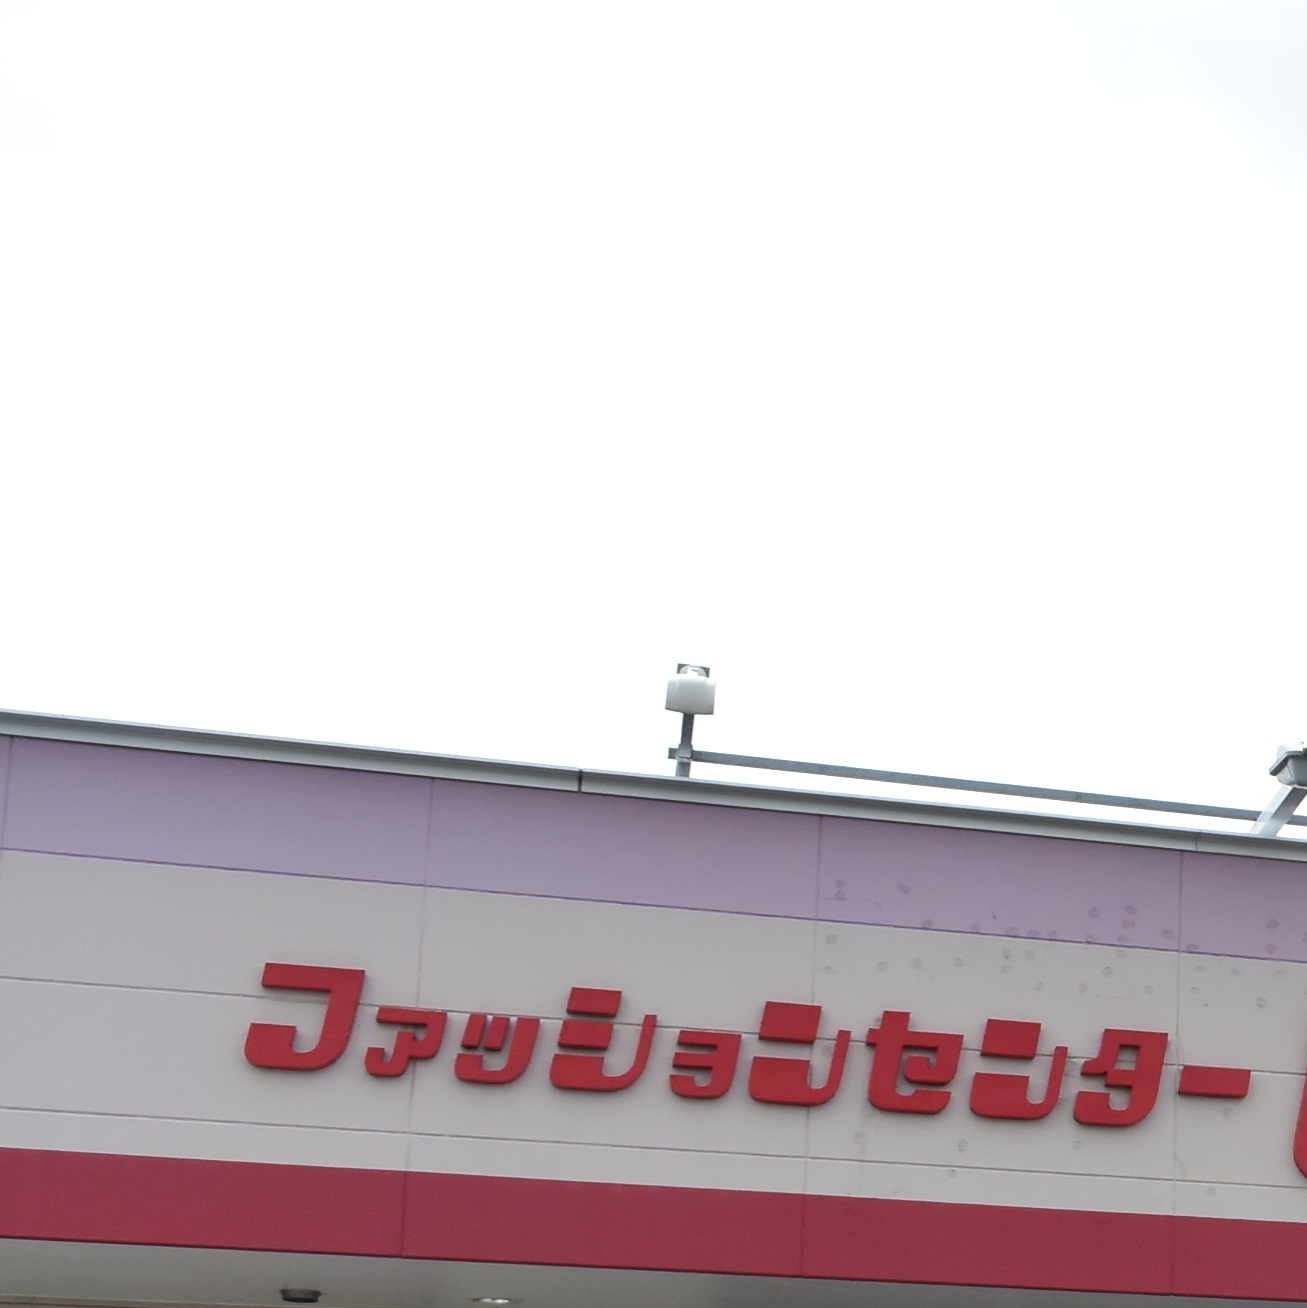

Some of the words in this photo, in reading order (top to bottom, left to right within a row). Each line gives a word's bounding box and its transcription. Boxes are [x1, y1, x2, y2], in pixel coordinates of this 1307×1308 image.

[244, 961, 1252, 1127] ファッションセンター
